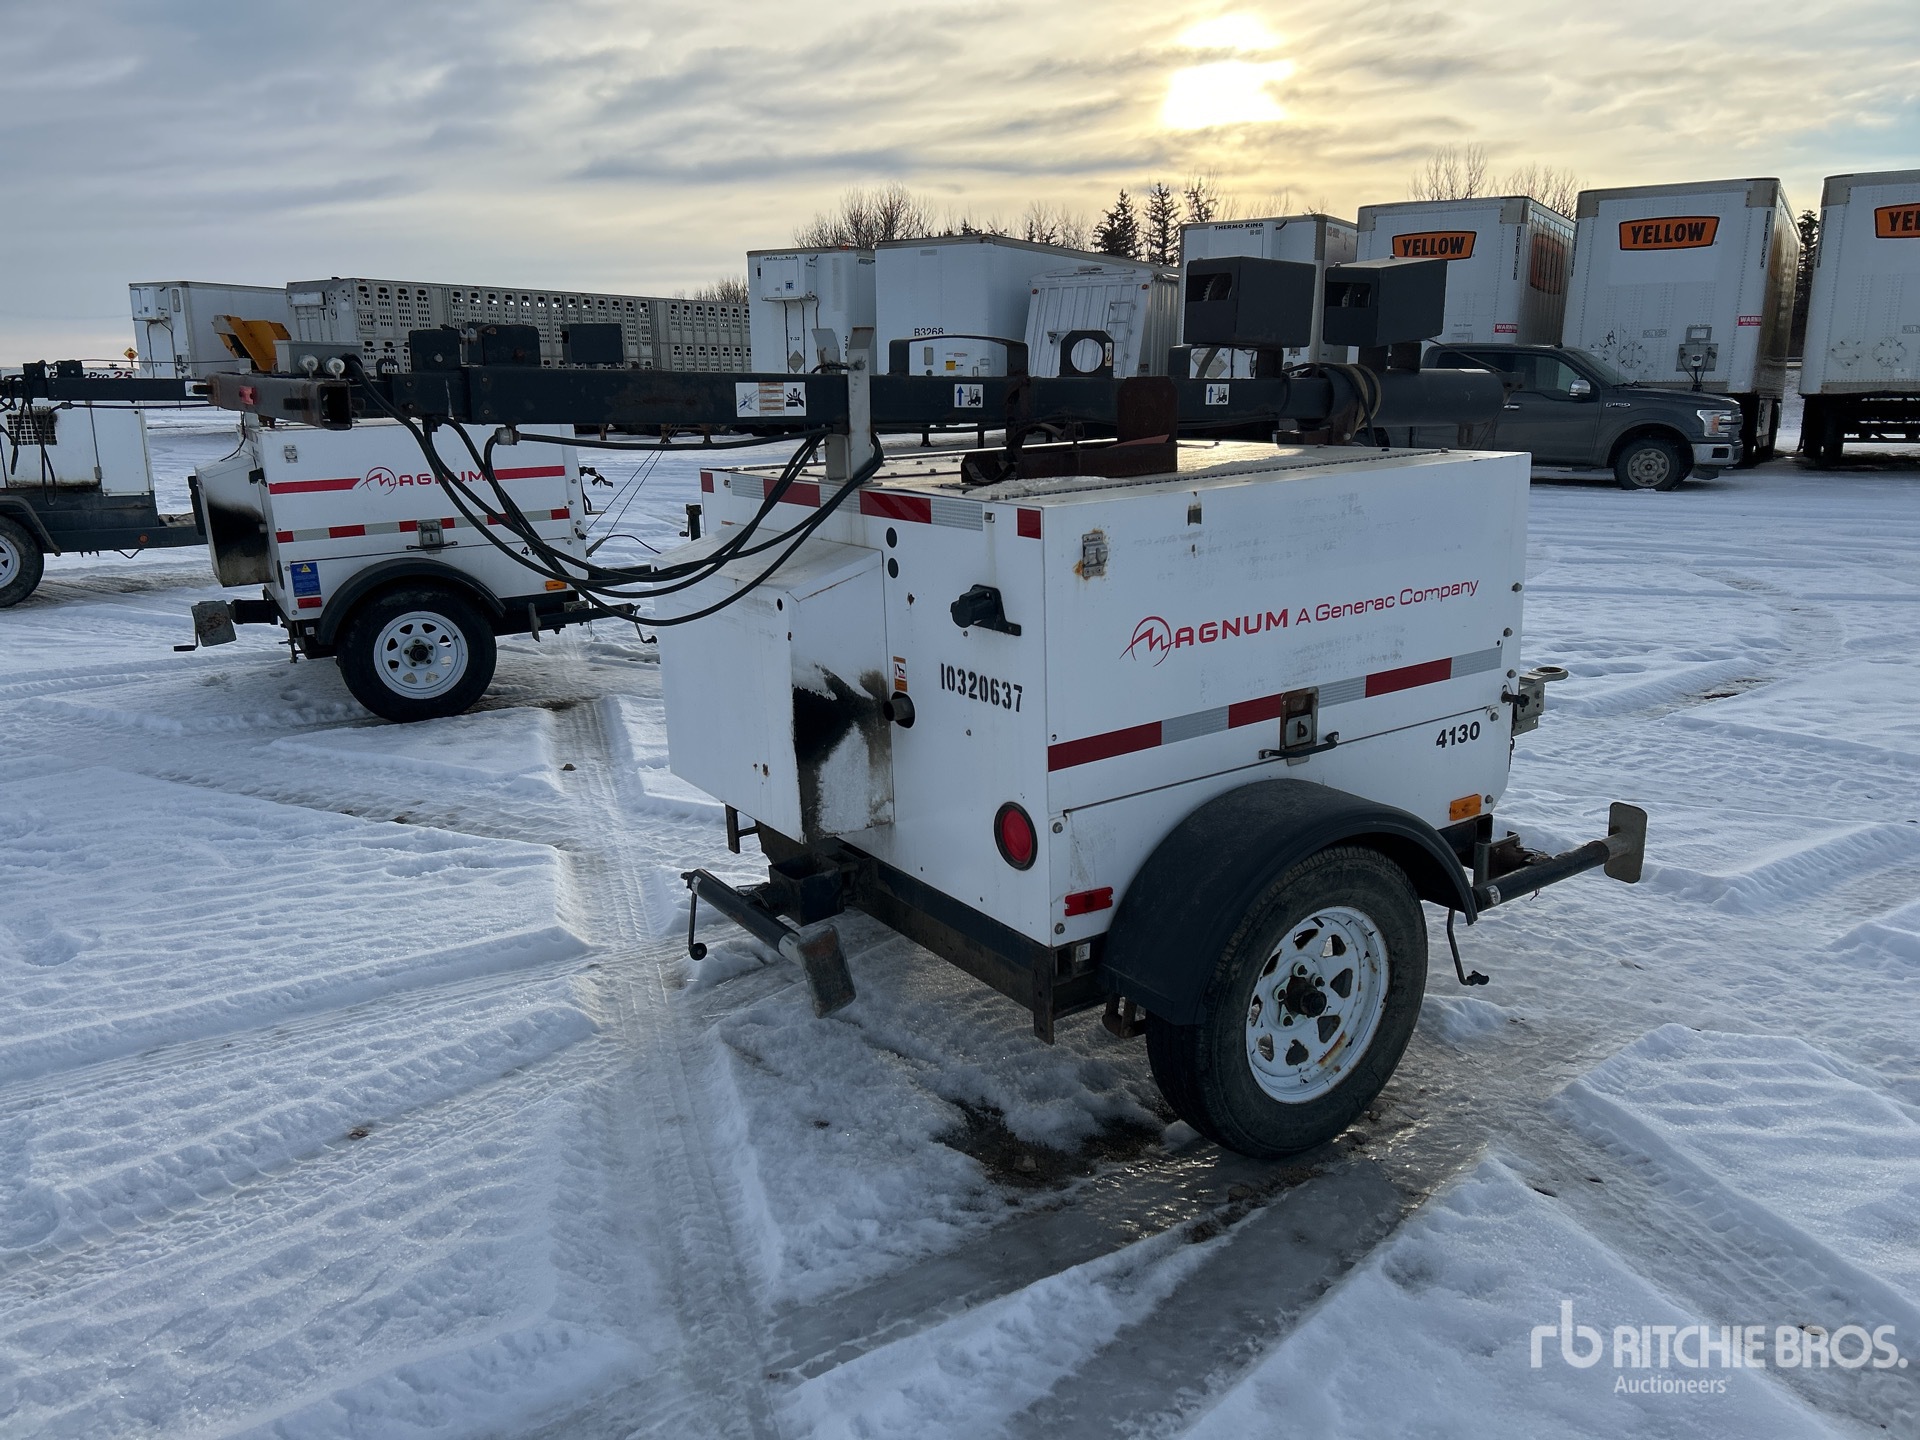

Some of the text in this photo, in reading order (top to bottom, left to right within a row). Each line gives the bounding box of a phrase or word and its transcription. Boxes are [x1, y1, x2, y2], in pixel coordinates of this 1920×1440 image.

[1402, 236, 1466, 257] YELLOW
[1630, 221, 1707, 245] YELLOW
[1295, 608, 1311, 626] A
[1315, 596, 1396, 622] Generac
[1399, 579, 1480, 606] Company
[940, 662, 1023, 712] 10320637
[1436, 721, 1480, 748] 4130
